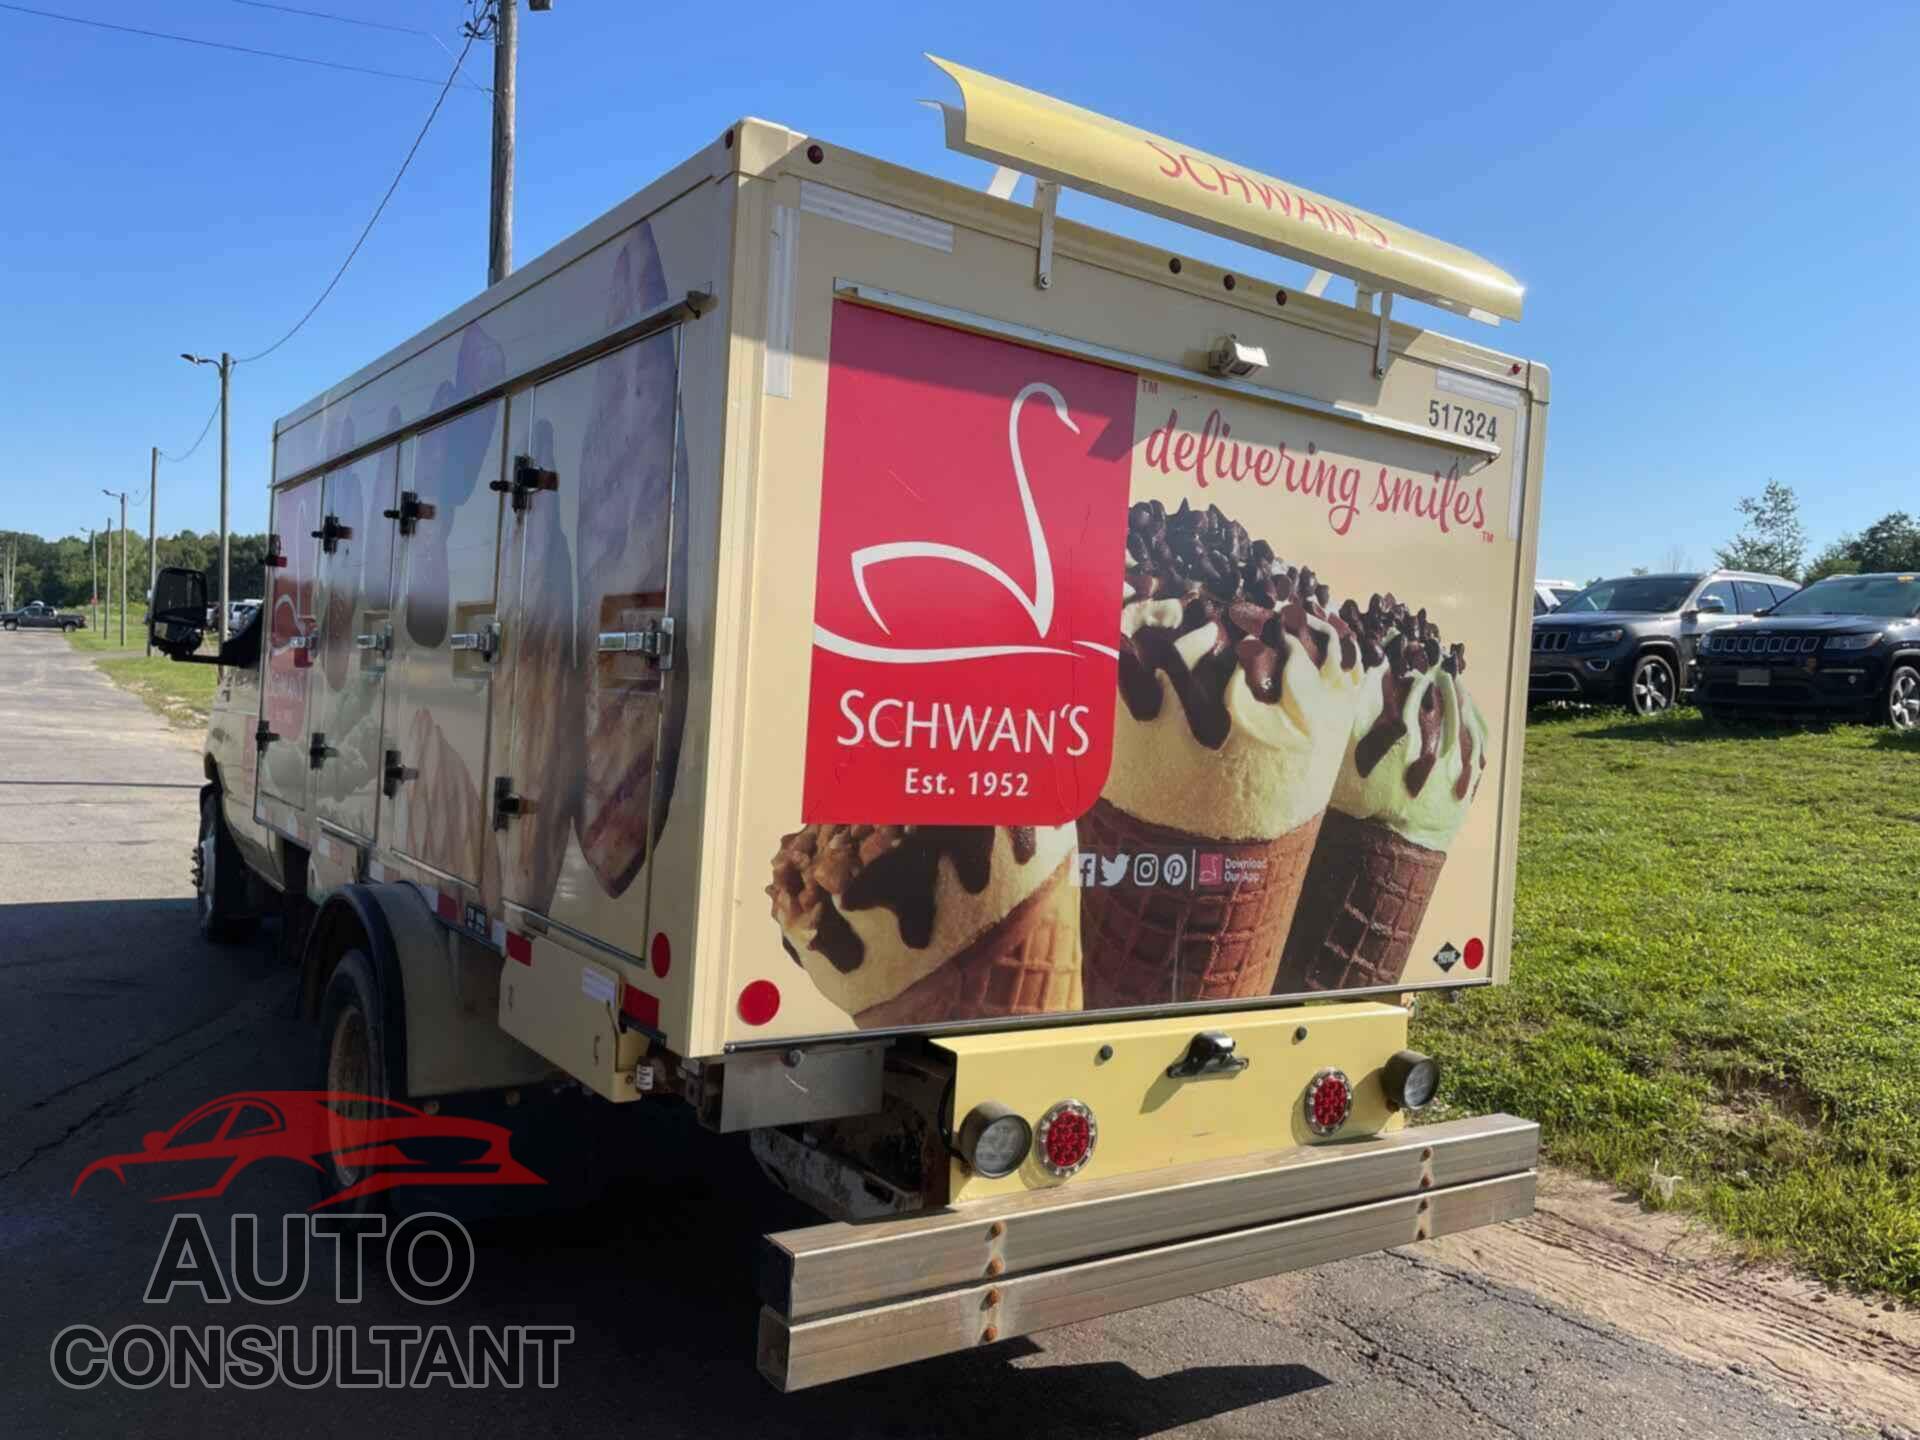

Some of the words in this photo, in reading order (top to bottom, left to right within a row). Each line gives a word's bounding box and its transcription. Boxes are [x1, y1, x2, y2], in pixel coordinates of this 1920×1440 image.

[1428, 399, 1497, 443] 517324
[1145, 408, 1361, 536] delivering
[1370, 459, 1486, 533] smiles
[836, 688, 1091, 757] SCHWAN'S
[904, 767, 956, 796] Est.
[967, 770, 1030, 797] 1952
